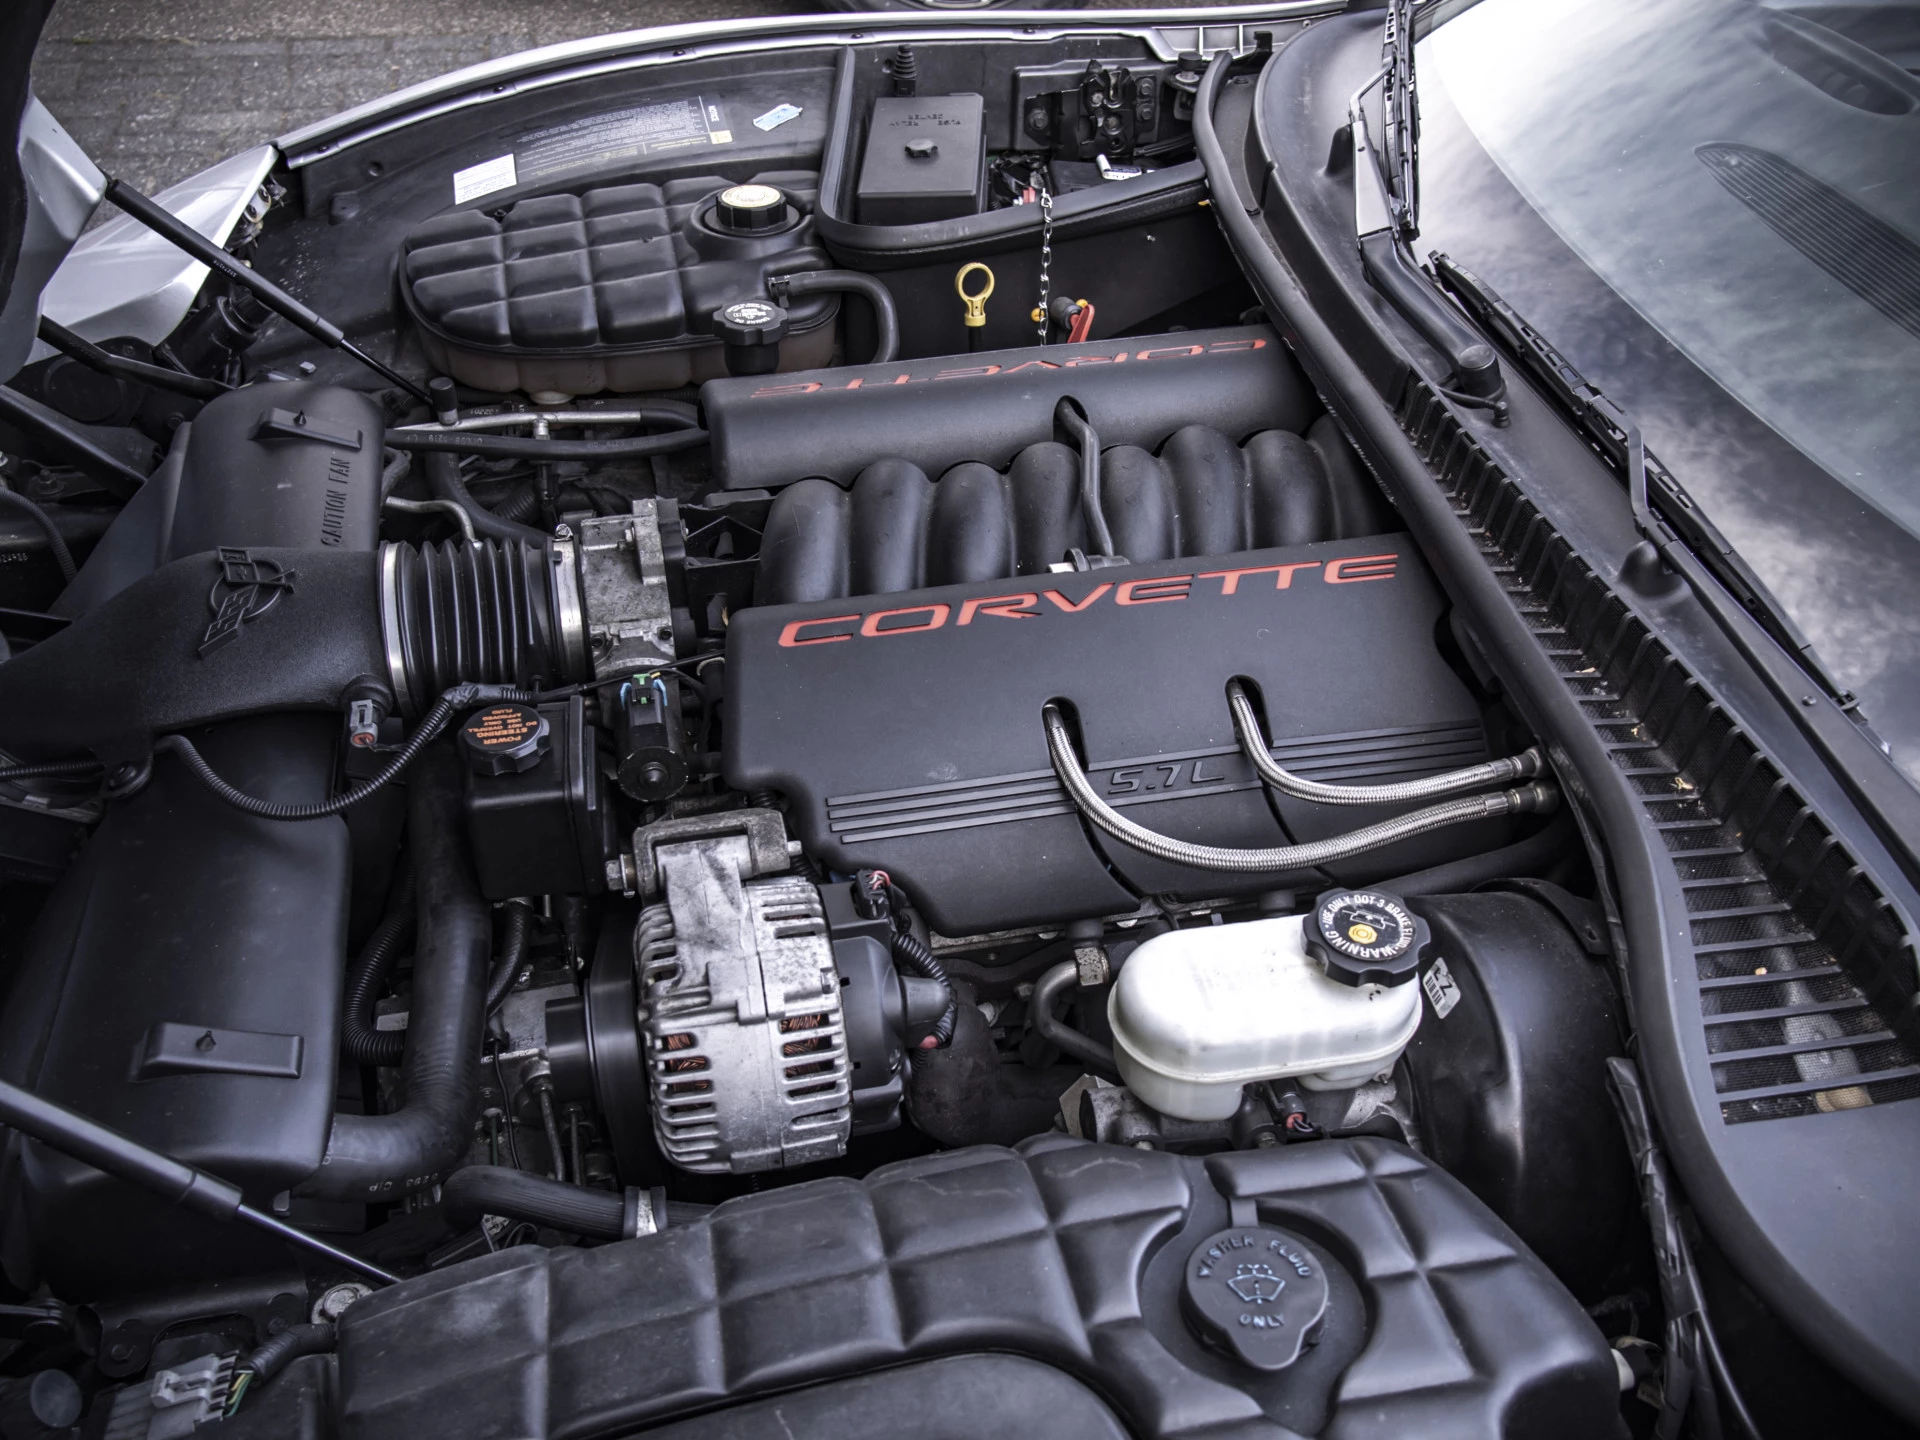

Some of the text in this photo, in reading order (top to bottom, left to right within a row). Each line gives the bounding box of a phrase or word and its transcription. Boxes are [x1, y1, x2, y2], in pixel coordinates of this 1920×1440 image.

[751, 338, 1266, 399] CORVETTE
[320, 457, 351, 547] CAUTION FAN
[777, 553, 1399, 648] CORVETTE
[476, 727, 528, 738] STEERING
[483, 735, 522, 745] POWER
[1108, 760, 1225, 795] 5.7L
[1327, 895, 1351, 914] ONLY
[1384, 903, 1412, 930] BRAKE
[1325, 930, 1398, 959] WARNING
[1396, 927, 1415, 951] FLUID
[1269, 1239, 1312, 1277] FLUID
[1239, 1313, 1285, 1328] ONLY
